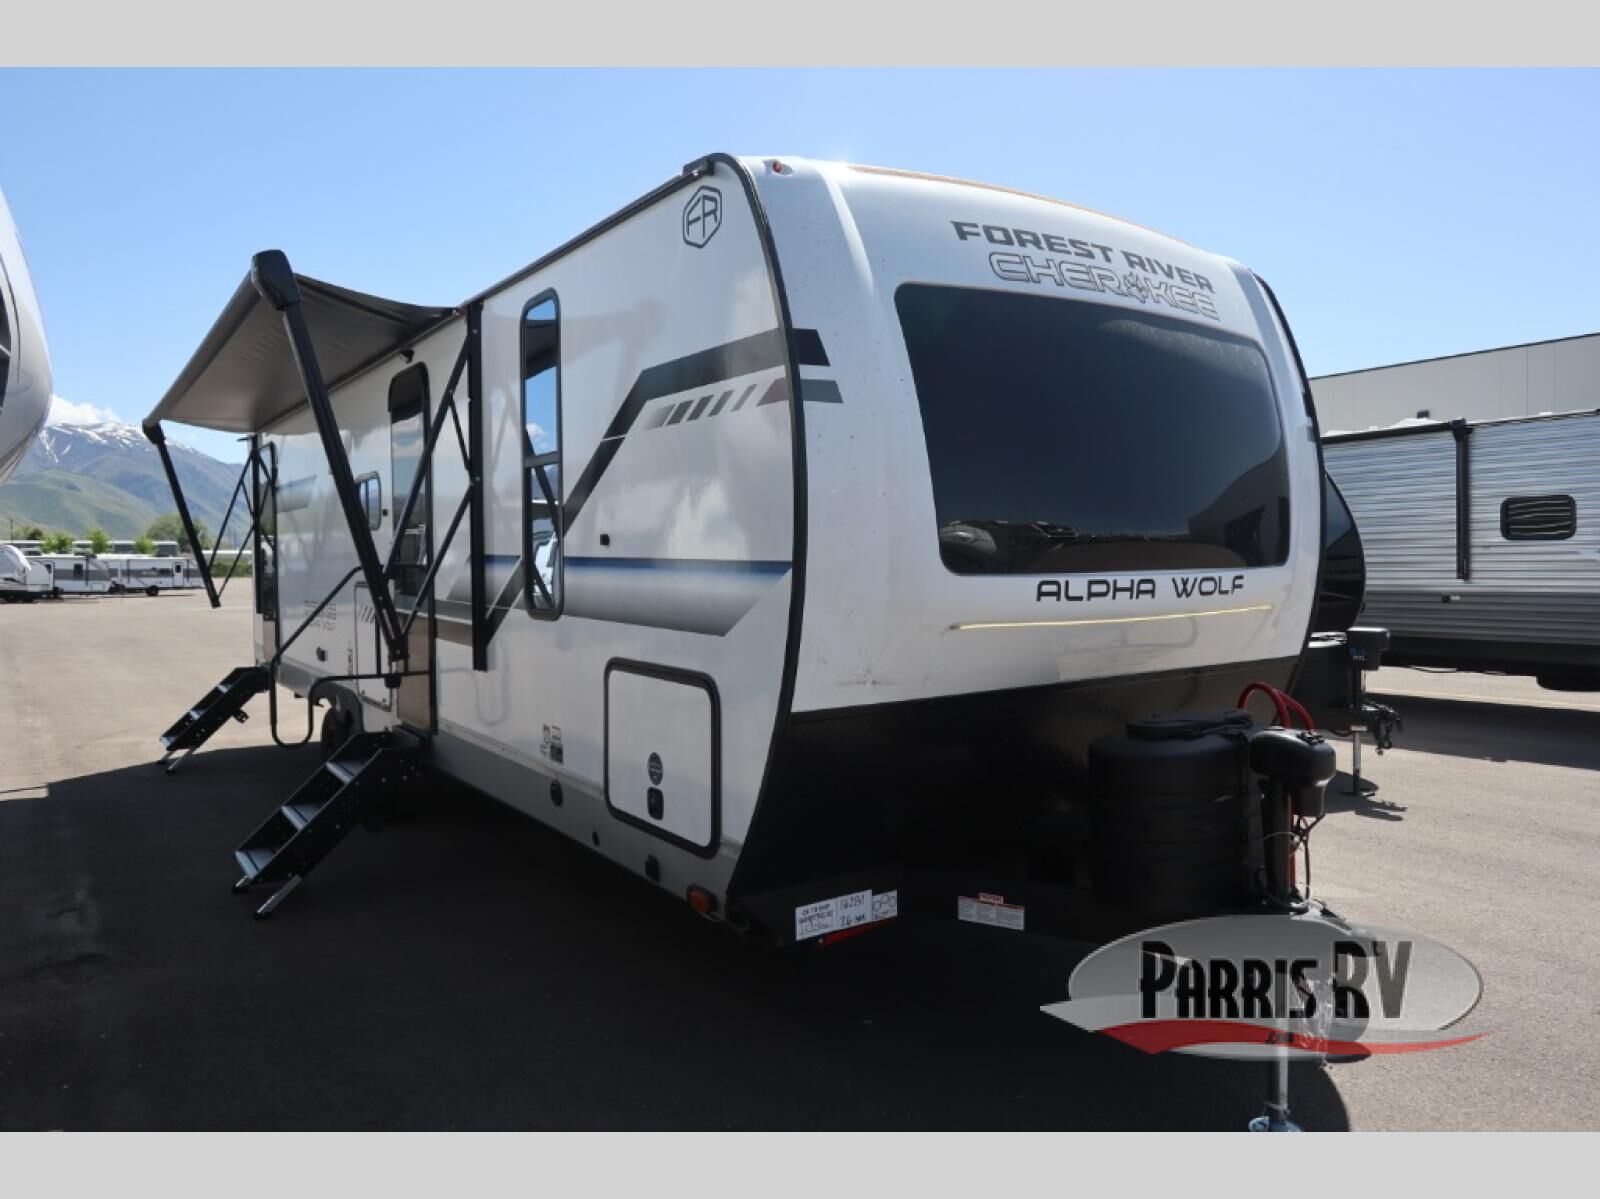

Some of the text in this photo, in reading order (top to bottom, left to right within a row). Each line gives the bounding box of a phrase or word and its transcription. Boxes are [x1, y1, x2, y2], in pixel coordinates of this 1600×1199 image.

[950, 220, 1216, 294] FOREST RIVER
[988, 251, 1221, 322] CHEROKEE
[1036, 574, 1245, 602] ALPHA WOLF
